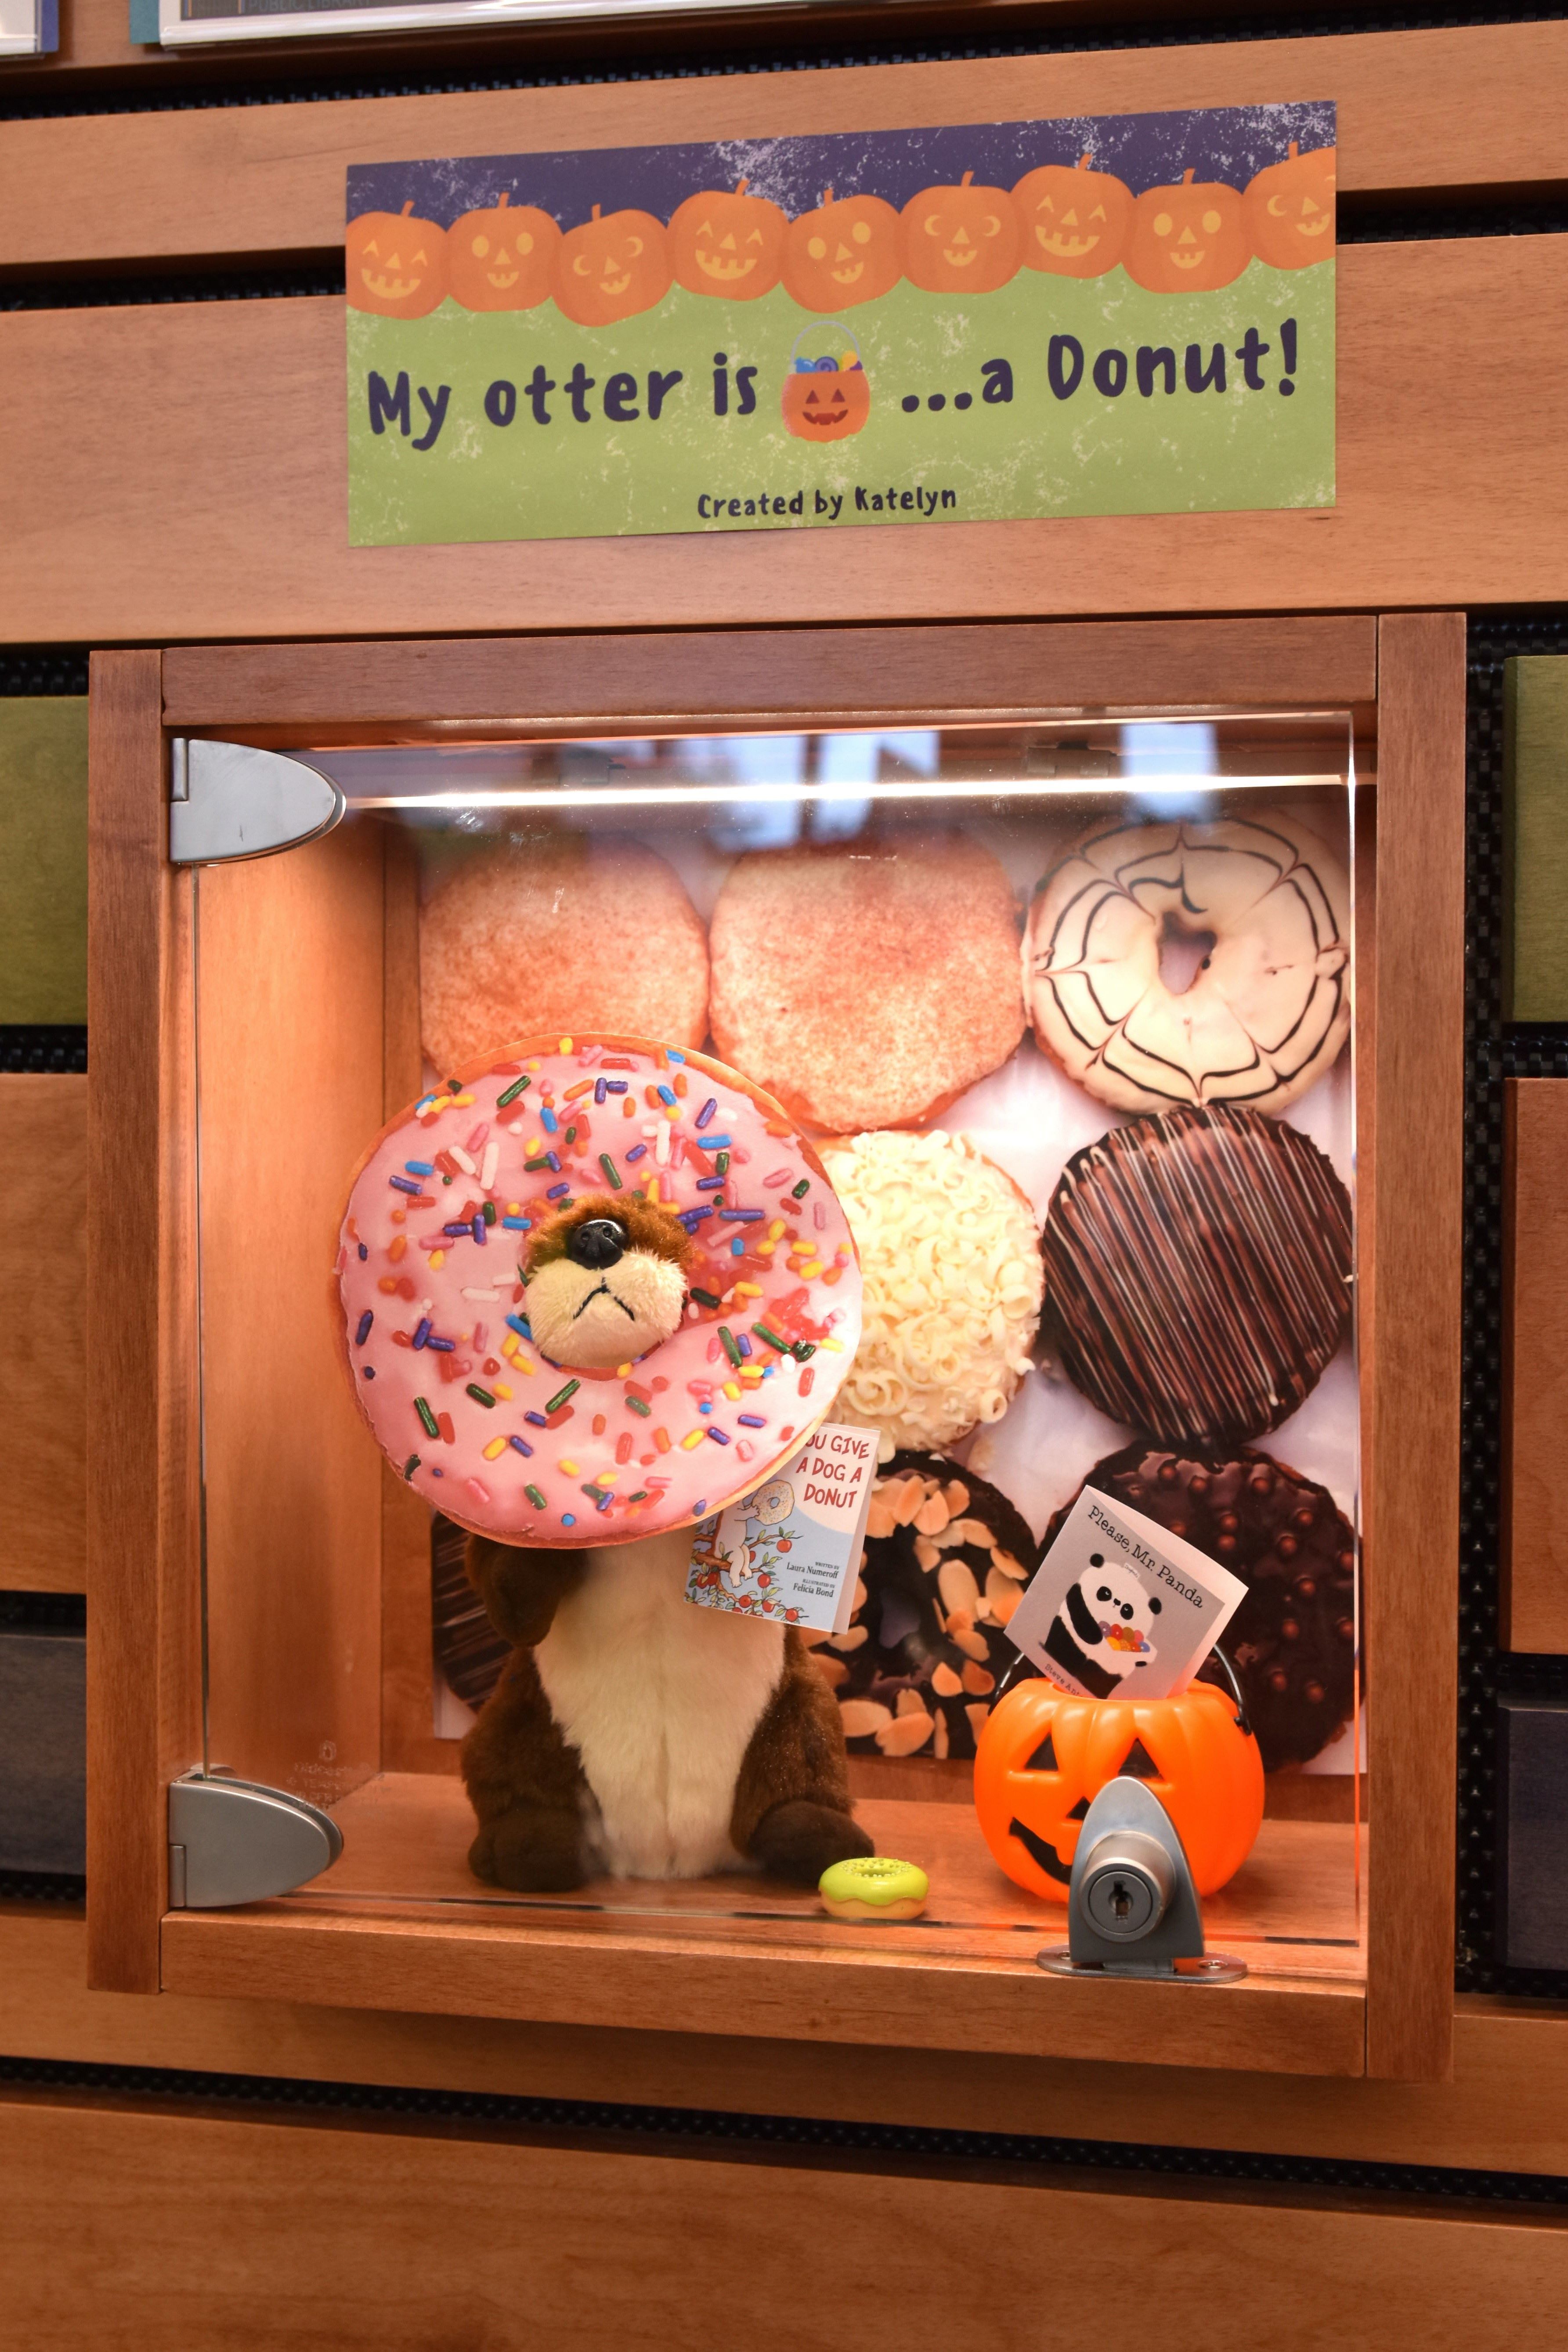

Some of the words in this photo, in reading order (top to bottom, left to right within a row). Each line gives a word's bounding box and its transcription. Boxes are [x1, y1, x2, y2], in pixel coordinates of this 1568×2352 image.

[368, 371, 452, 451] My
[484, 363, 683, 427] otter
[713, 352, 758, 416] is
[1048, 318, 1297, 400] Donut!
[697, 490, 804, 519] Created
[815, 489, 843, 520] by
[855, 486, 956, 516] Katelyn
[805, 1434, 827, 1449] OU
[831, 1435, 869, 1459] GIVE
[796, 1457, 808, 1473] A
[812, 1458, 846, 1481] DOG
[849, 1467, 862, 1483] A
[804, 1483, 857, 1508] DONUT
[1088, 1505, 1131, 1553] Please,
[1131, 1544, 1154, 1572] Mr.
[1157, 1565, 1203, 1609] Panda
[787, 1562, 805, 1572] Laura
[806, 1566, 839, 1579] Numeroff
[793, 1583, 814, 1594] Felicia
[816, 1587, 834, 1597] Bond
